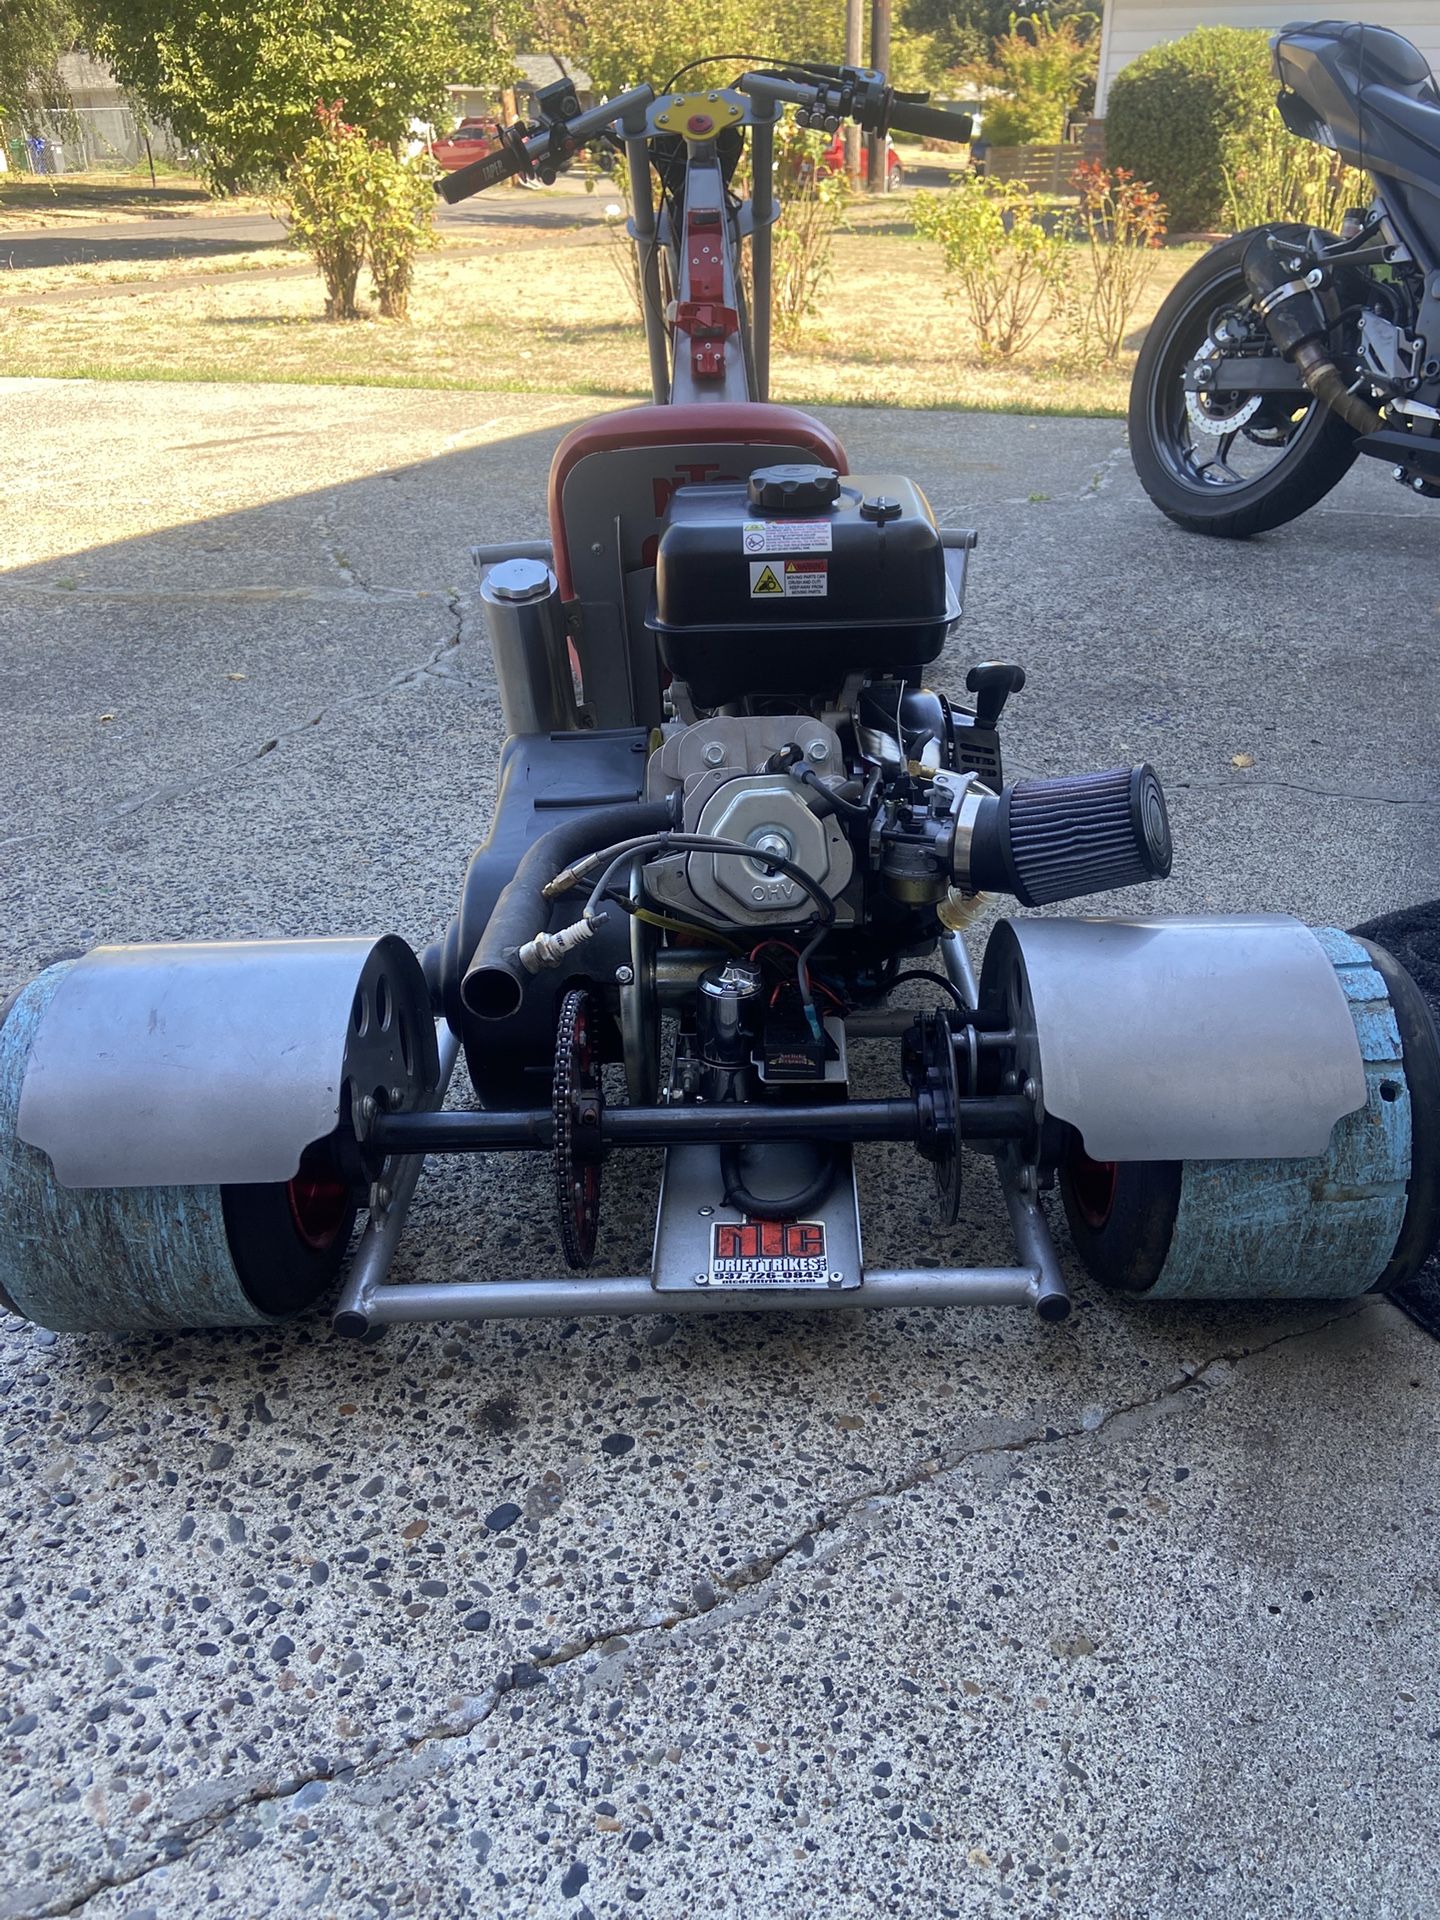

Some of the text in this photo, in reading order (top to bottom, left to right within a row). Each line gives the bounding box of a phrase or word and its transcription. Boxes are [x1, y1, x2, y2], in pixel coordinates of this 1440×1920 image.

[751, 883, 795, 901] OHV
[715, 1217, 824, 1258] NTC
[713, 1258, 760, 1272] DRIFT
[761, 1257, 819, 1271] TRIKES
